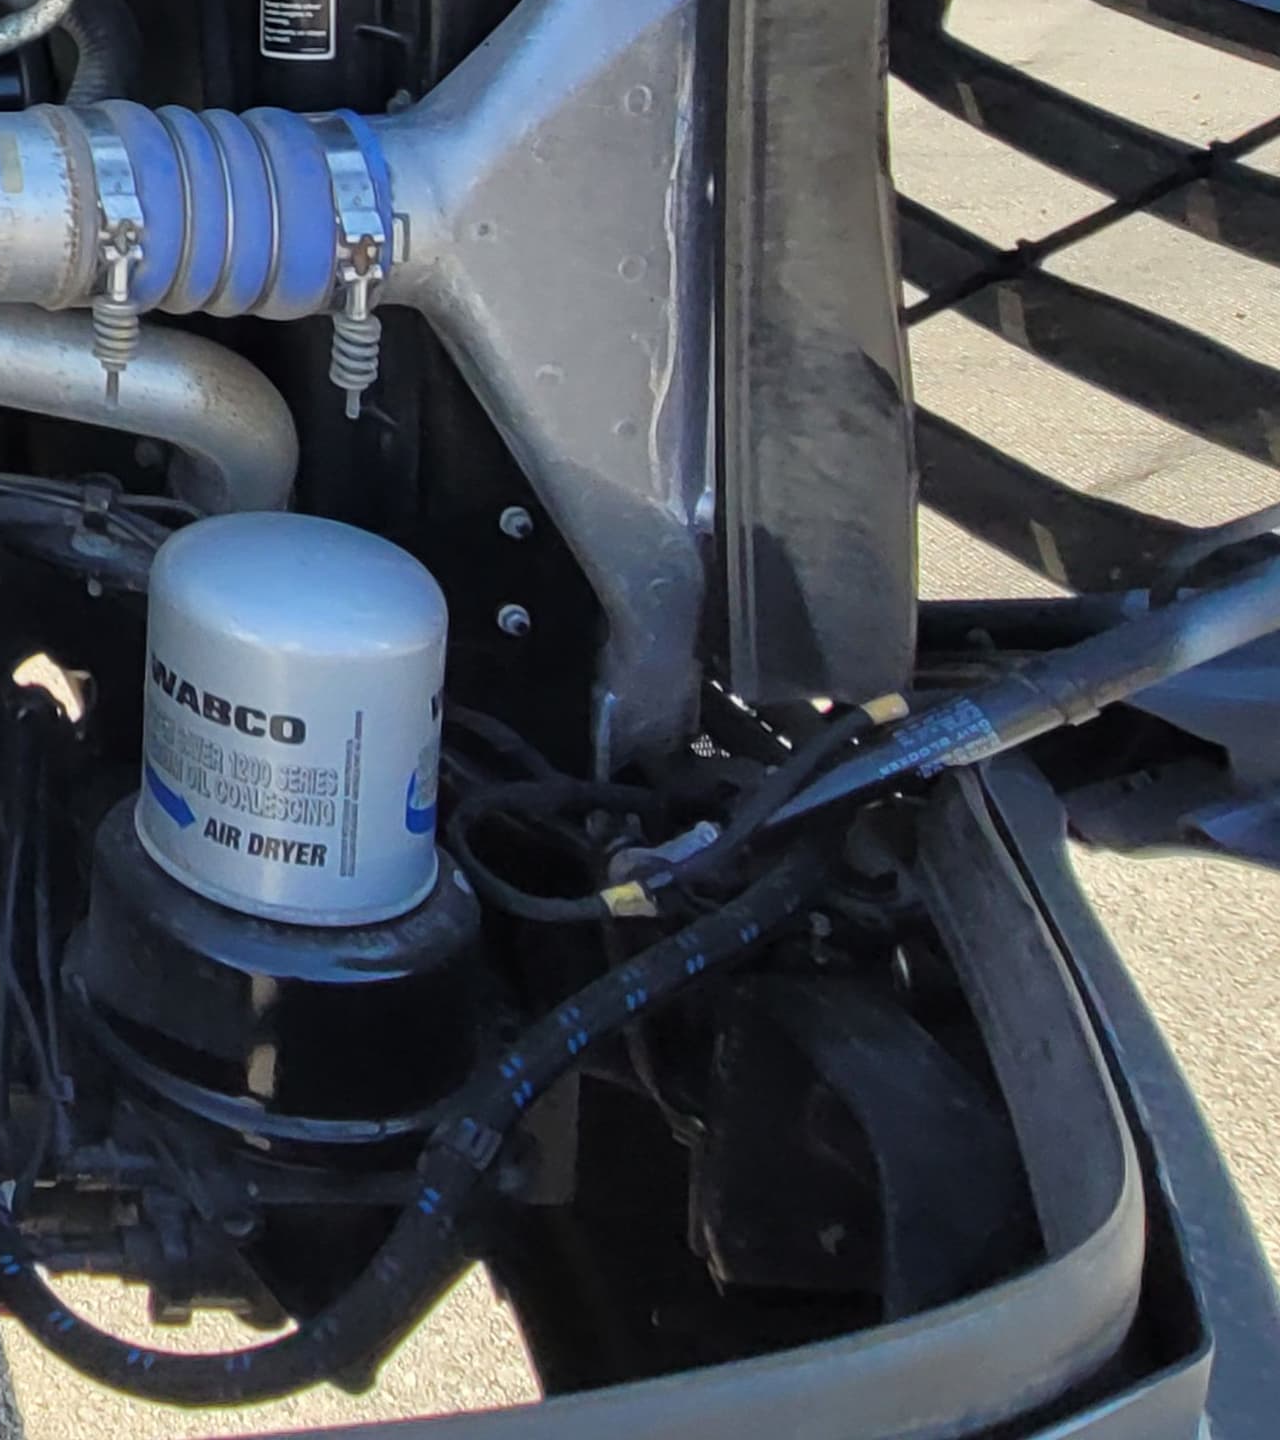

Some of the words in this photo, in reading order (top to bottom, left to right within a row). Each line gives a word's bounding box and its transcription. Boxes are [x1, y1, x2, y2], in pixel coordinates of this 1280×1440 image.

[228, 749, 273, 789] 1200
[278, 765, 339, 798] SERIES
[216, 776, 337, 828] COALESCING
[203, 815, 243, 851] AIR
[247, 831, 329, 868] DRYER
